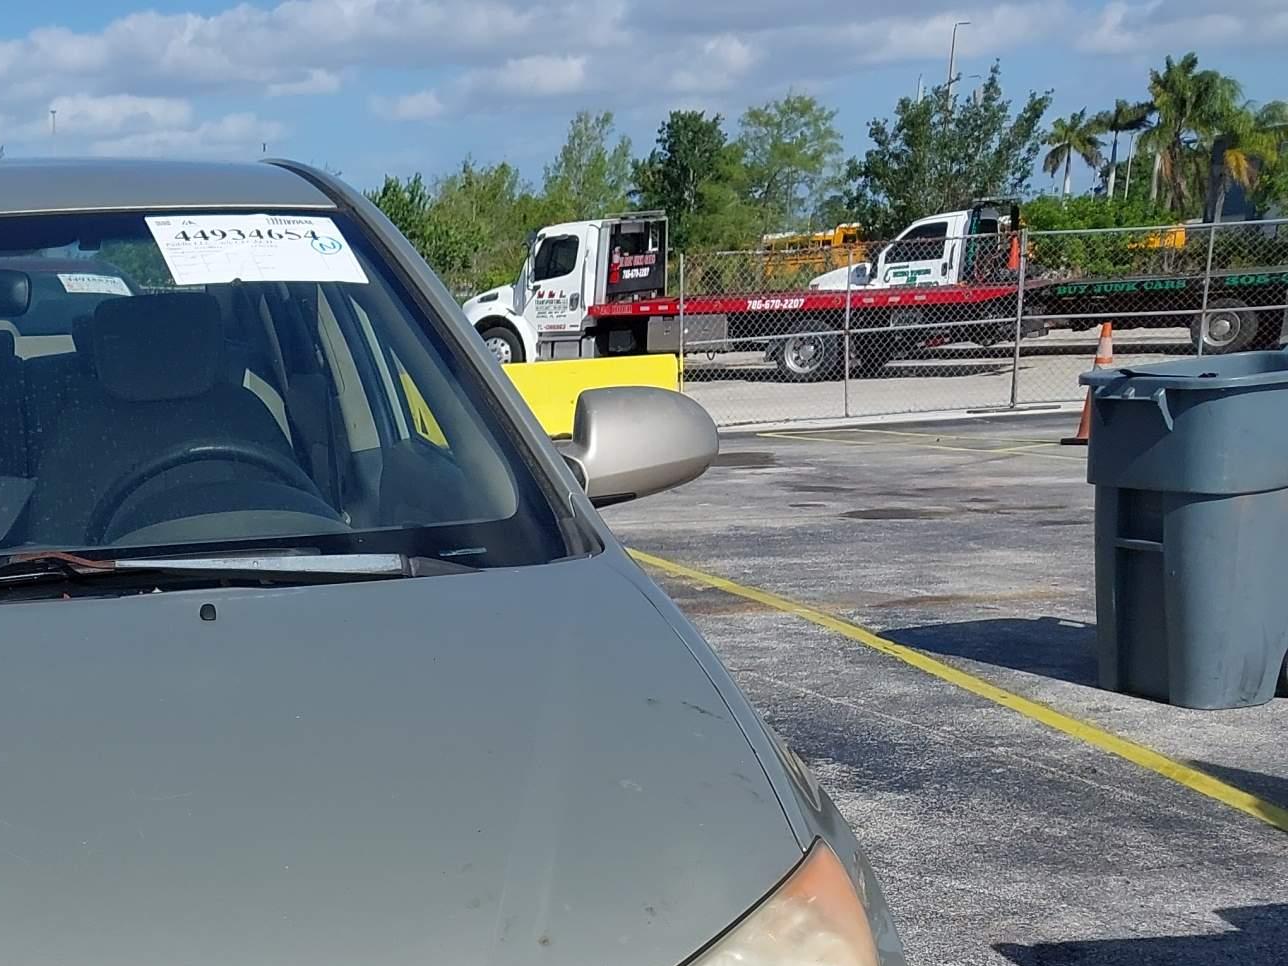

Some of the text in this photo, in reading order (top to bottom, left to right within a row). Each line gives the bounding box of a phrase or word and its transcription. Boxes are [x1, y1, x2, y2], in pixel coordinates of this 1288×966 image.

[174, 228, 319, 242] 44934654
[1057, 280, 1187, 295] BUY JUNK CARS
[747, 298, 805, 310] 786-670-2207
